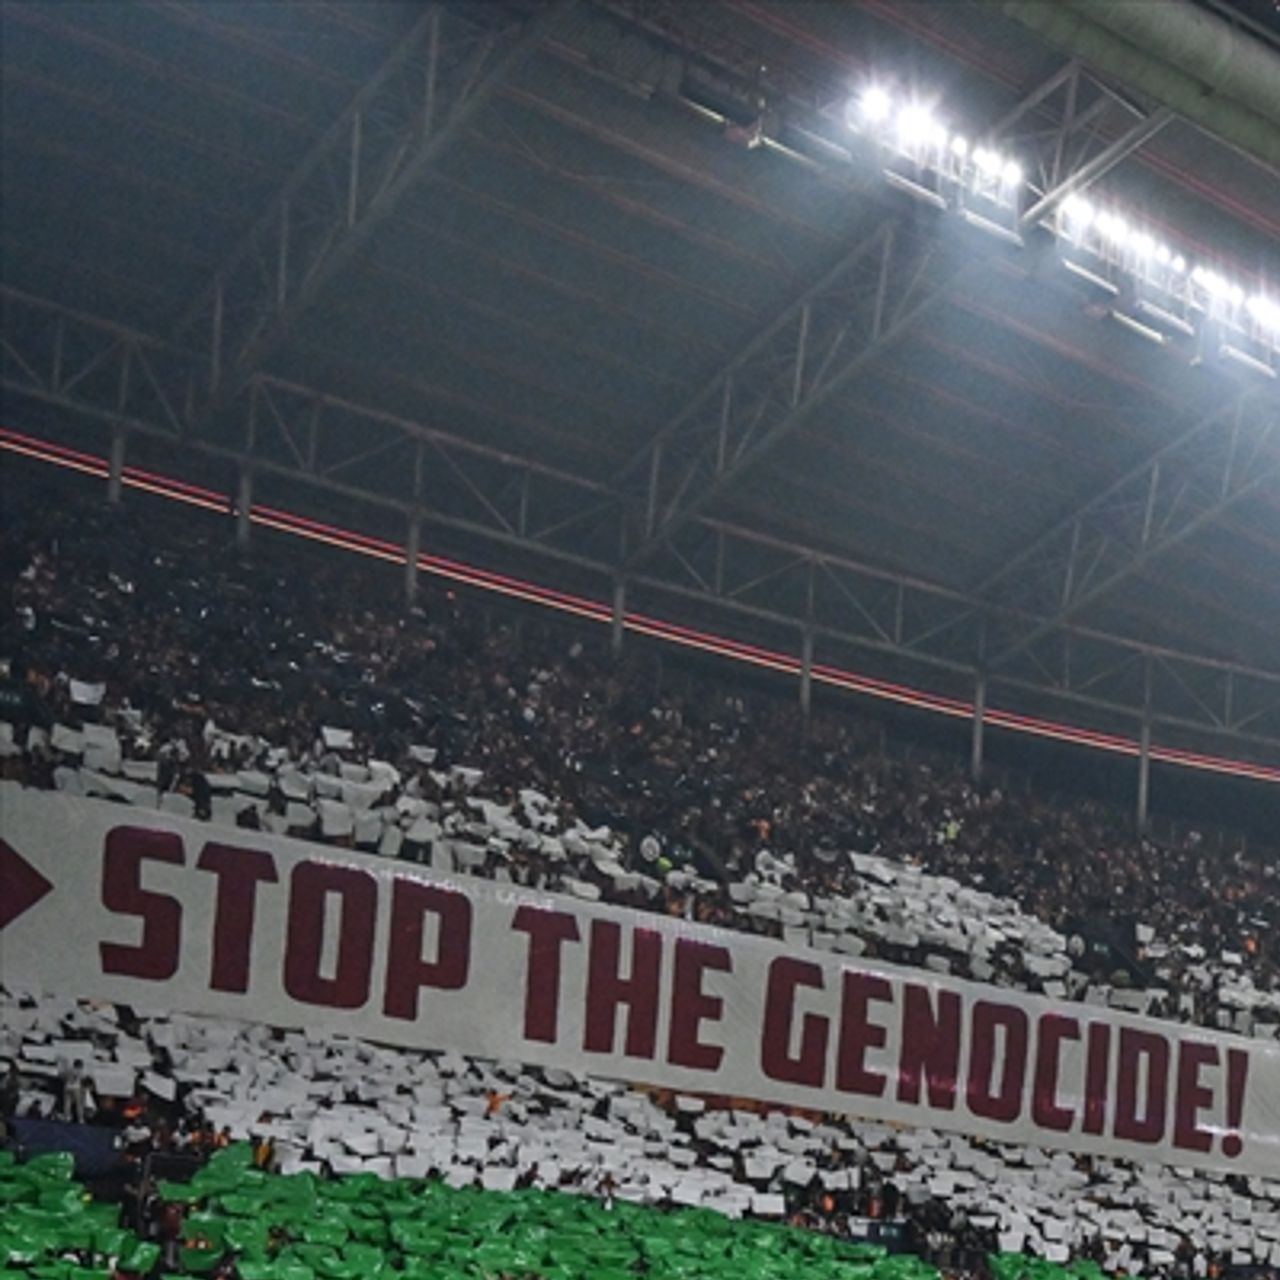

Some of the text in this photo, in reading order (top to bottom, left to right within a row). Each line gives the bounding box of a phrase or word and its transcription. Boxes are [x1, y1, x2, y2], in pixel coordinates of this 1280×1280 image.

[99, 825, 1249, 1159] STOP THE GENOCIDE!
